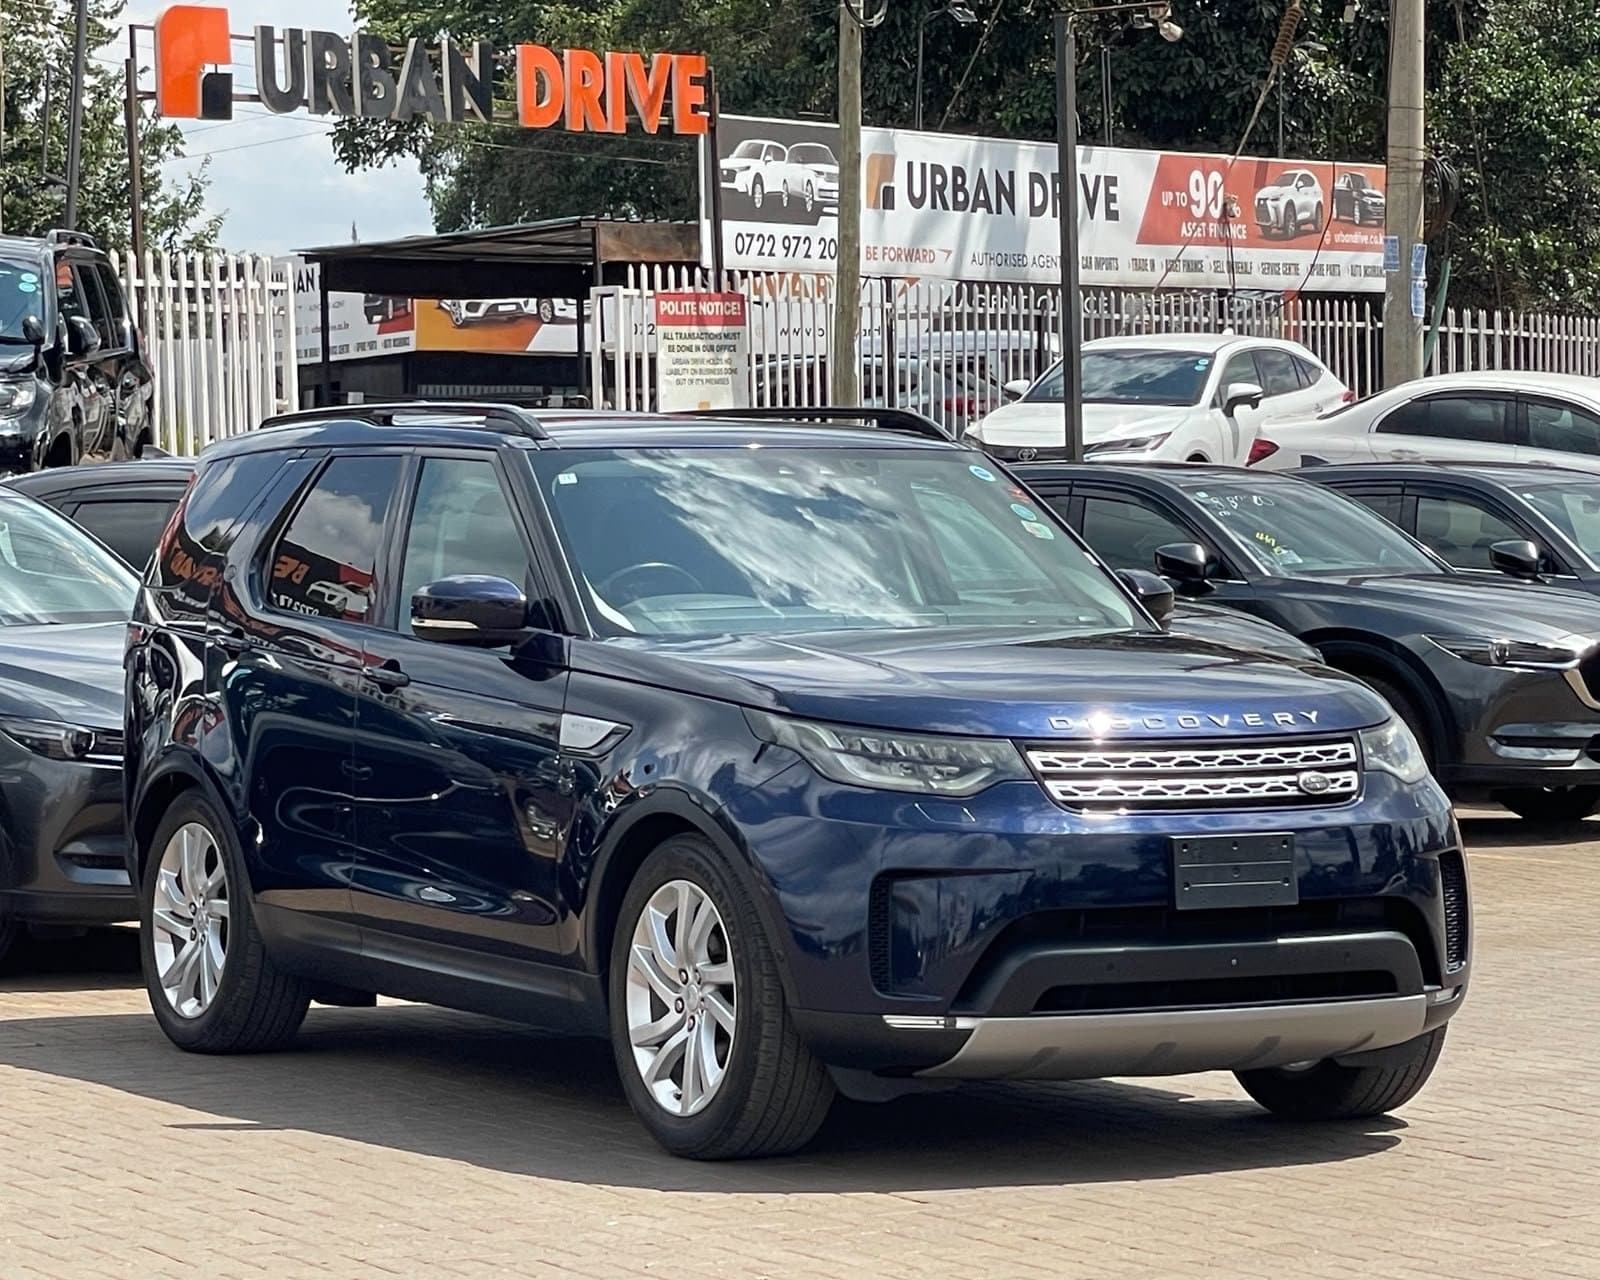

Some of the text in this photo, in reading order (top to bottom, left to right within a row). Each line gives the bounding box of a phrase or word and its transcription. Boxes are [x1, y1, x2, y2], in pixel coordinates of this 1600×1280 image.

[254, 25, 709, 135] URBAN DRIVE
[907, 160, 1119, 221] URBAN DRVE
[1161, 191, 1174, 207] UP
[1175, 191, 1188, 207] TO
[1181, 221, 1247, 239] ASSET FINANCE
[735, 232, 776, 257] 0722
[782, 235, 812, 259] 972
[865, 245, 936, 264] BE FORWARD
[971, 252, 1028, 268] AUTHORISED
[660, 301, 741, 316] POLITE NOTICE!
[663, 332, 741, 341] ALL TRANSACTIONS MUST
[668, 344, 736, 353] BE DONE IN OUR OFFICE
